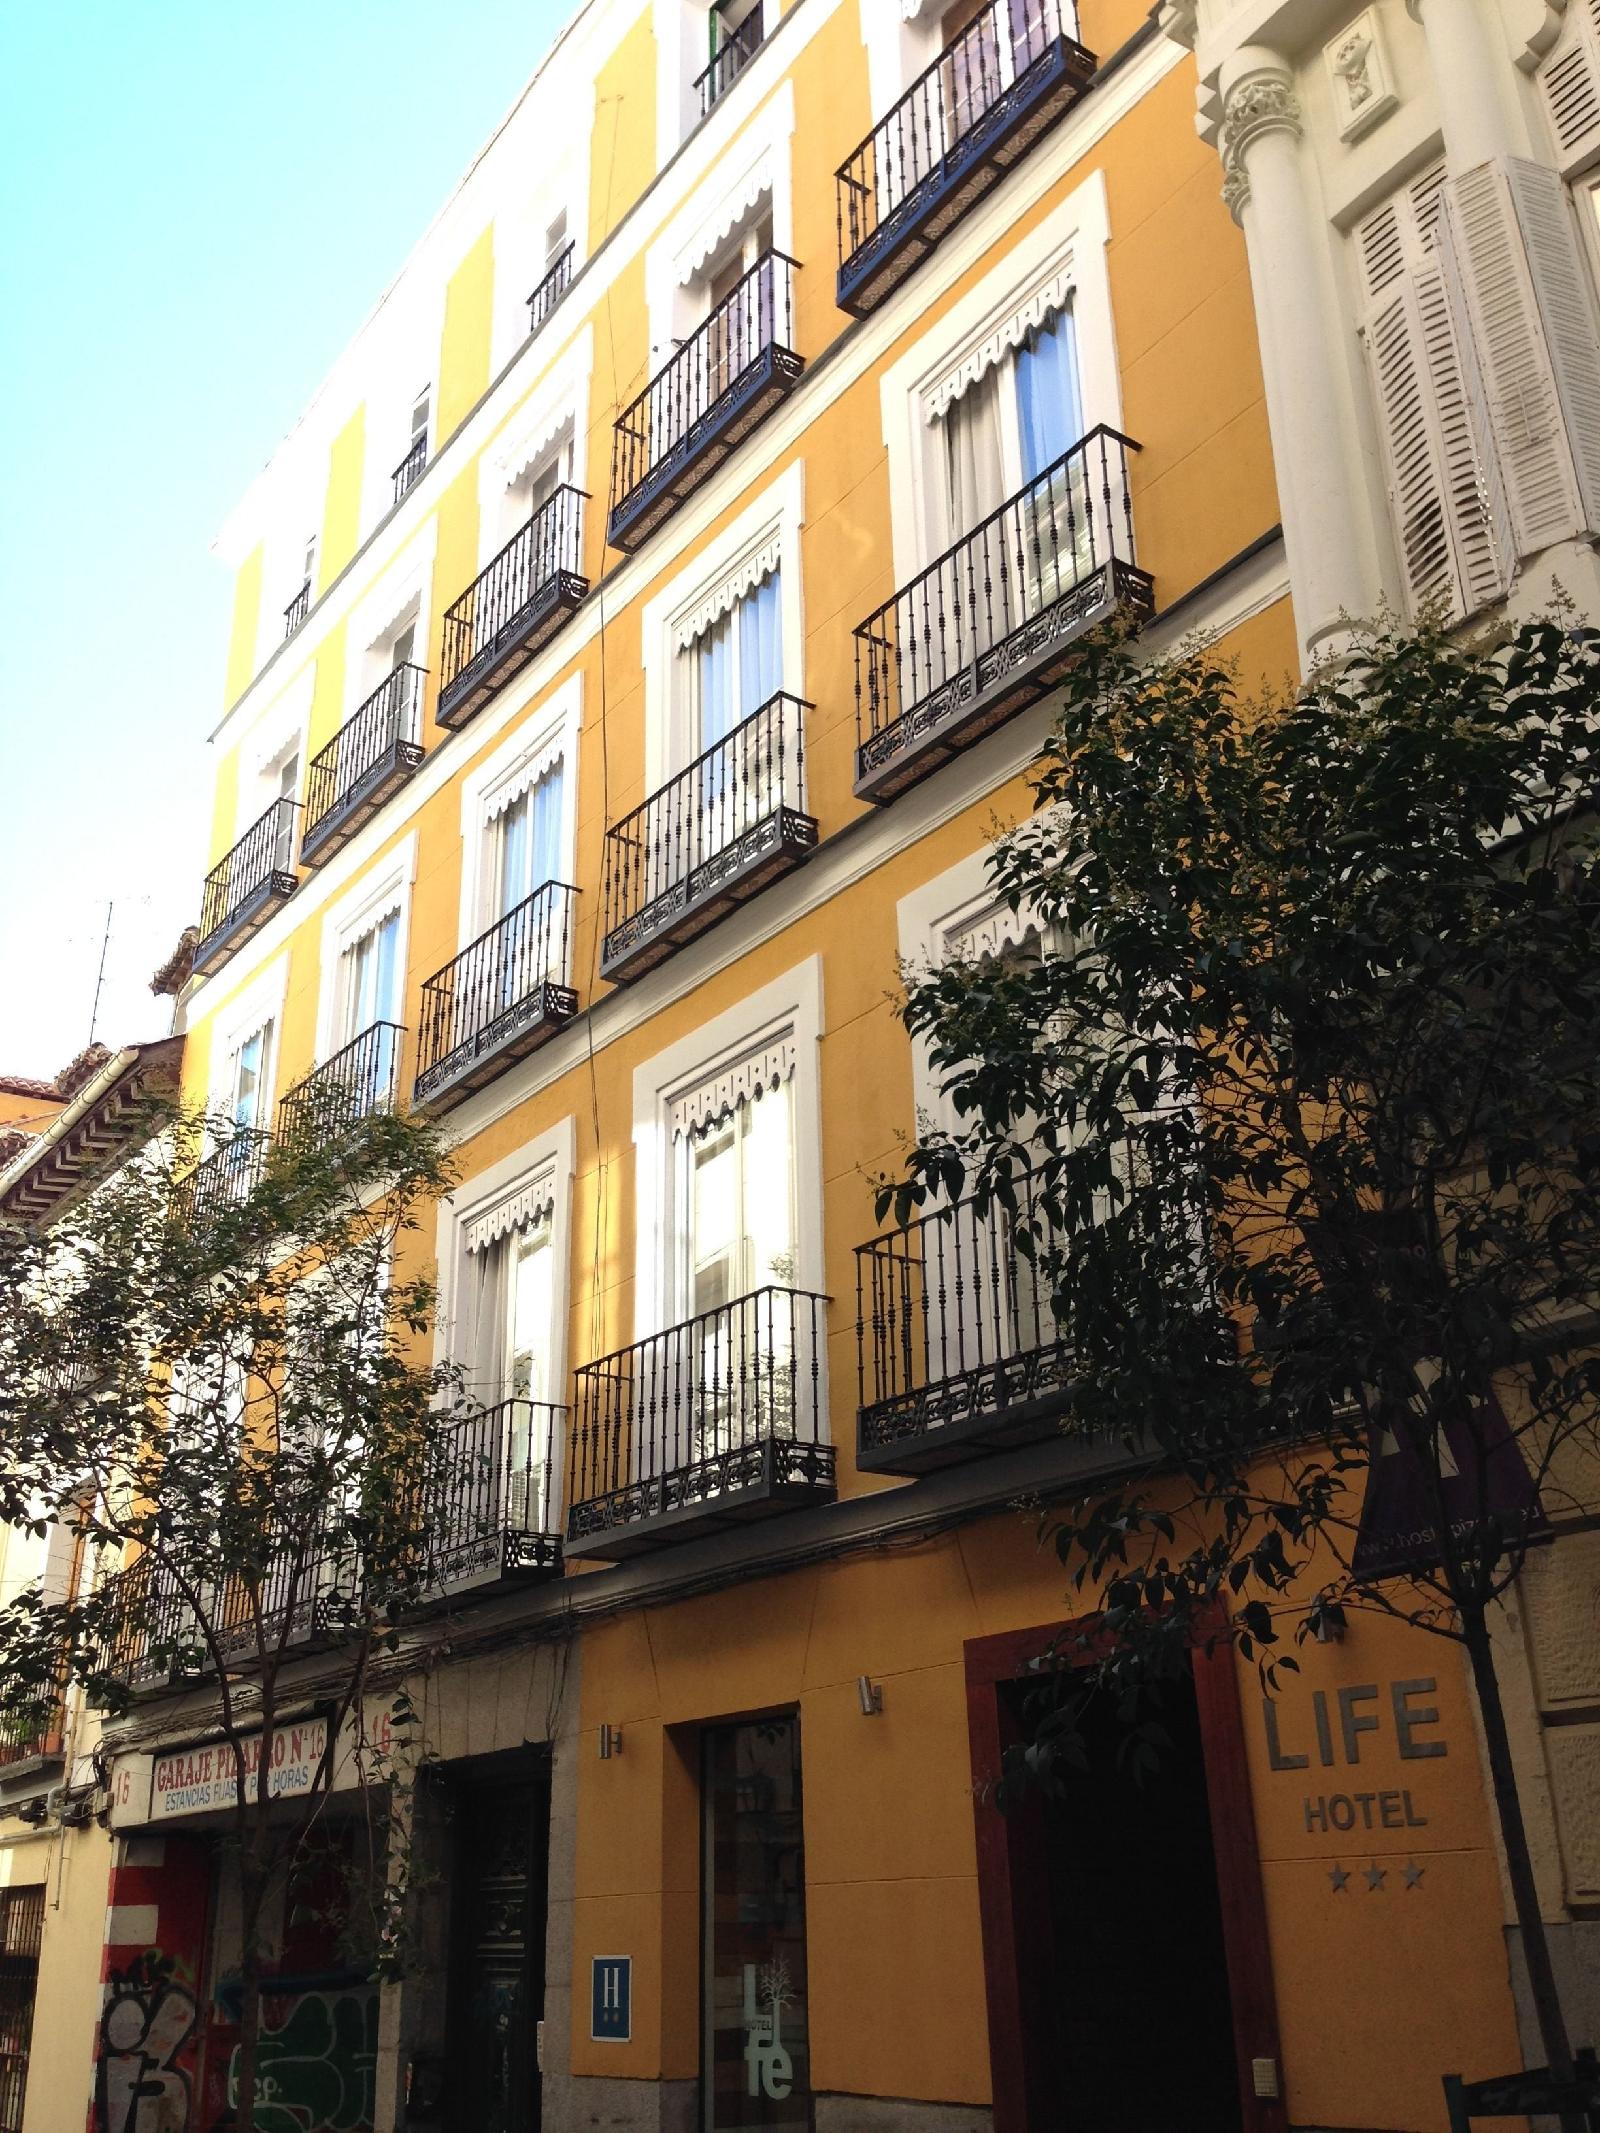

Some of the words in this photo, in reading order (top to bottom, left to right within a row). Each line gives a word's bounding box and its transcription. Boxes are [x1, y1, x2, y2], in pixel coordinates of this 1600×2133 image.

[372, 1712, 391, 1753] 16
[1263, 1677, 1447, 1771] LIFE
[157, 1752, 213, 1793] GARAJE
[309, 1723, 324, 1760] 16
[116, 1771, 130, 1806] 16
[165, 1785, 210, 1812] ESTANCIAS
[273, 1765, 309, 1792] HORAS
[1303, 1790, 1428, 1832] HOTEL
[602, 1967, 621, 2009] H
